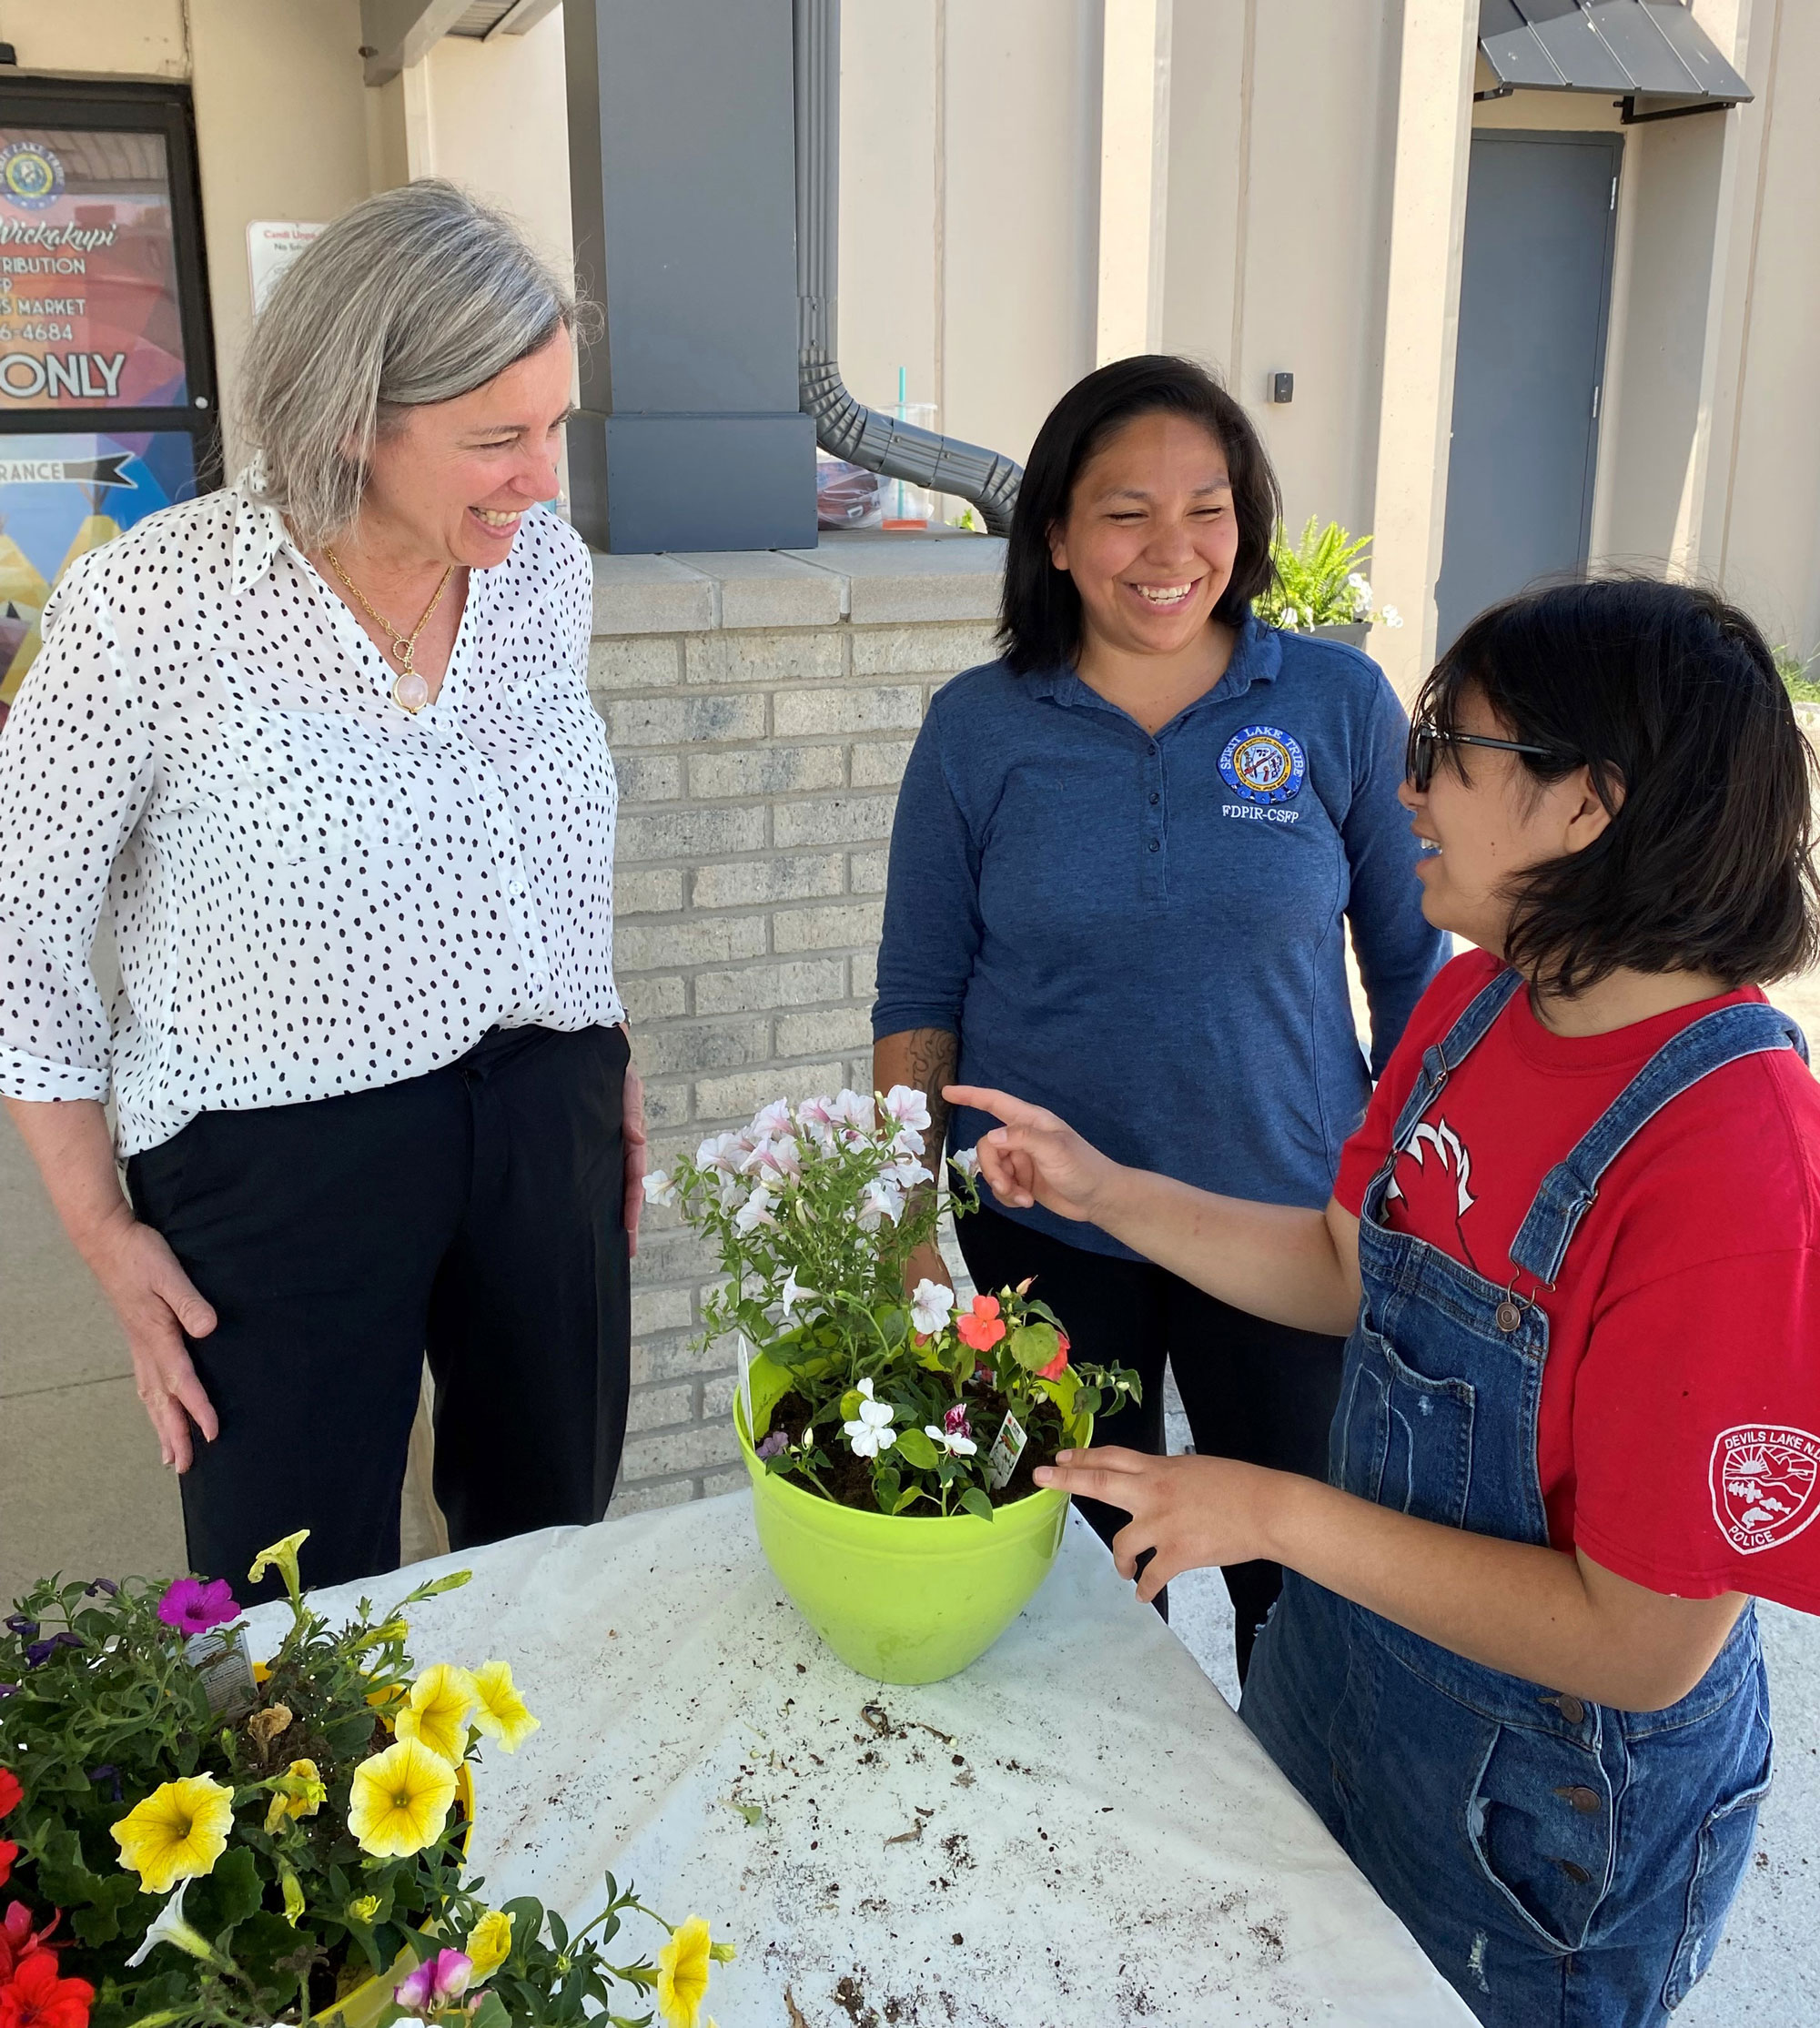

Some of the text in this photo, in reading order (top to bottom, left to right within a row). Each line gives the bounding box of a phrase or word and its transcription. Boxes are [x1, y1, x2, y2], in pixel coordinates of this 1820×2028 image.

[0, 257, 86, 275] RIBUTION
[17, 298, 86, 317] MARKET
[0, 352, 126, 399] ONLY
[1220, 735, 1241, 770] SPIRIT
[1243, 726, 1283, 739] LAKE
[1285, 738, 1304, 777] TRIBE
[1221, 804, 1299, 823] FDPIR-CSFP
[1724, 1431, 1766, 1449] DEVILS
[1769, 1432, 1804, 1448] LAKE
[1728, 1525, 1774, 1546] POLICE
